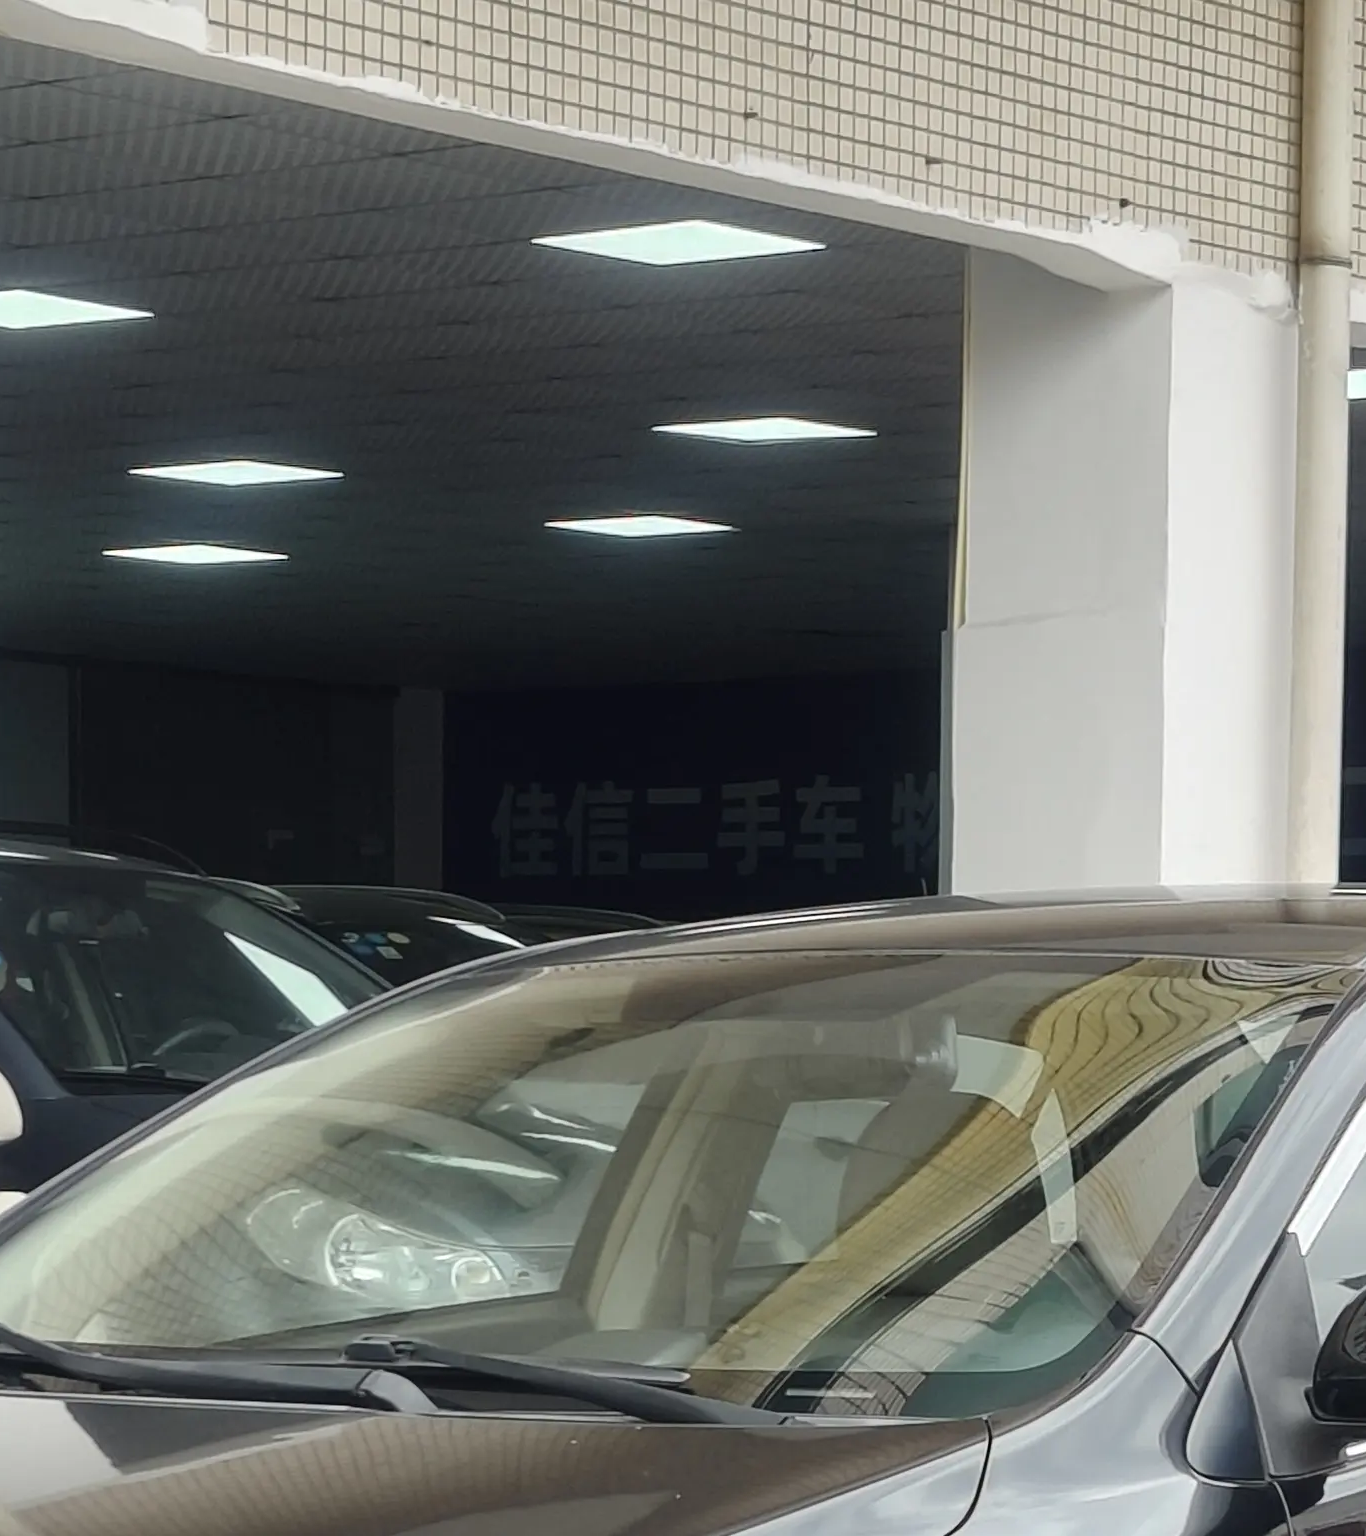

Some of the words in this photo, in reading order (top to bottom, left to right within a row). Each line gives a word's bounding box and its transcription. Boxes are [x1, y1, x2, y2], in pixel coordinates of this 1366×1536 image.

[492, 775, 864, 877] 佳信二手车
